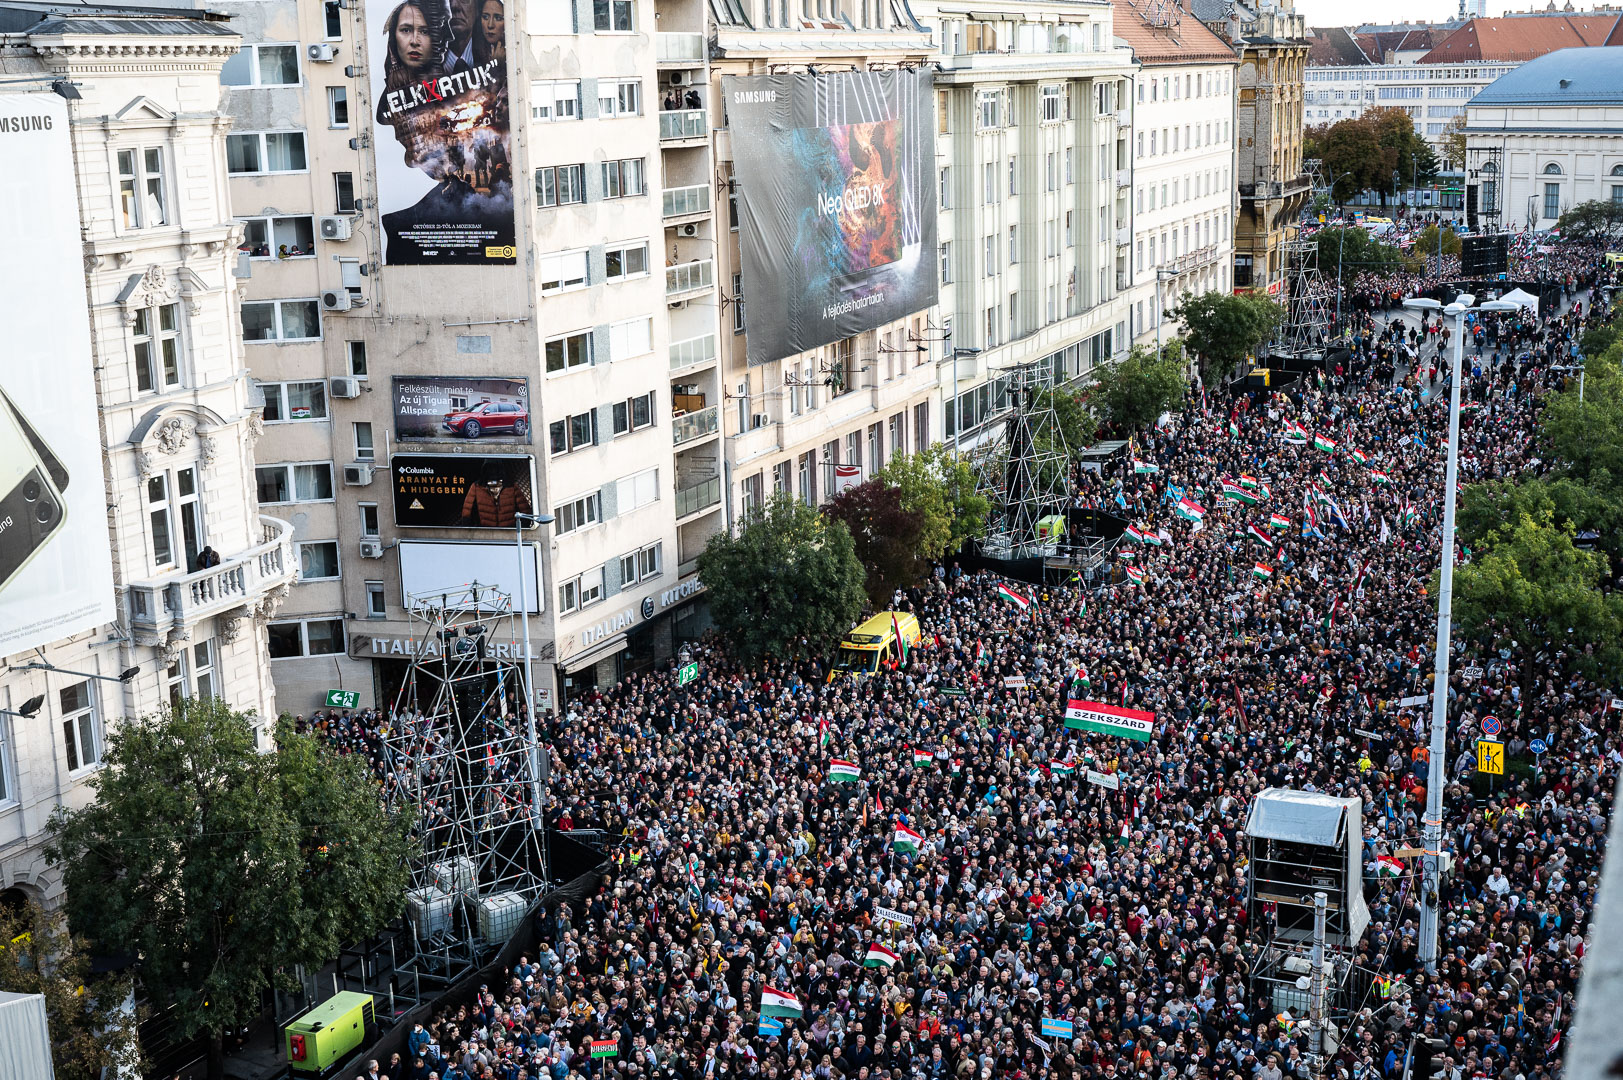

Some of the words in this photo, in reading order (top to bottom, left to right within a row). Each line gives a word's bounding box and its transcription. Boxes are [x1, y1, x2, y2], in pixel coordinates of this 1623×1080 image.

[734, 90, 776, 104] SAMSUNG
[817, 192, 843, 217] Neo
[844, 186, 871, 211] QLED
[872, 182, 885, 206] 8K
[822, 307, 828, 320] A
[828, 300, 852, 320] fejlődés
[399, 384, 442, 395] Felkészült,
[444, 386, 465, 394] mint
[465, 387, 474, 395] te
[399, 395, 412, 404] Az
[413, 395, 421, 406] új
[422, 395, 453, 406] Tiguan
[400, 405, 438, 416] Allspace
[405, 466, 435, 474] Columbia
[399, 476, 448, 484] ARANYAT
[453, 475, 465, 485] ÉR
[411, 486, 464, 494] HIDEGBEN
[661, 577, 704, 607] KITCHE
[582, 608, 635, 646] ITALIAN
[1073, 711, 1146, 729] SZEKSZÁRD
[877, 908, 912, 924] ZALAEGERSZEG
